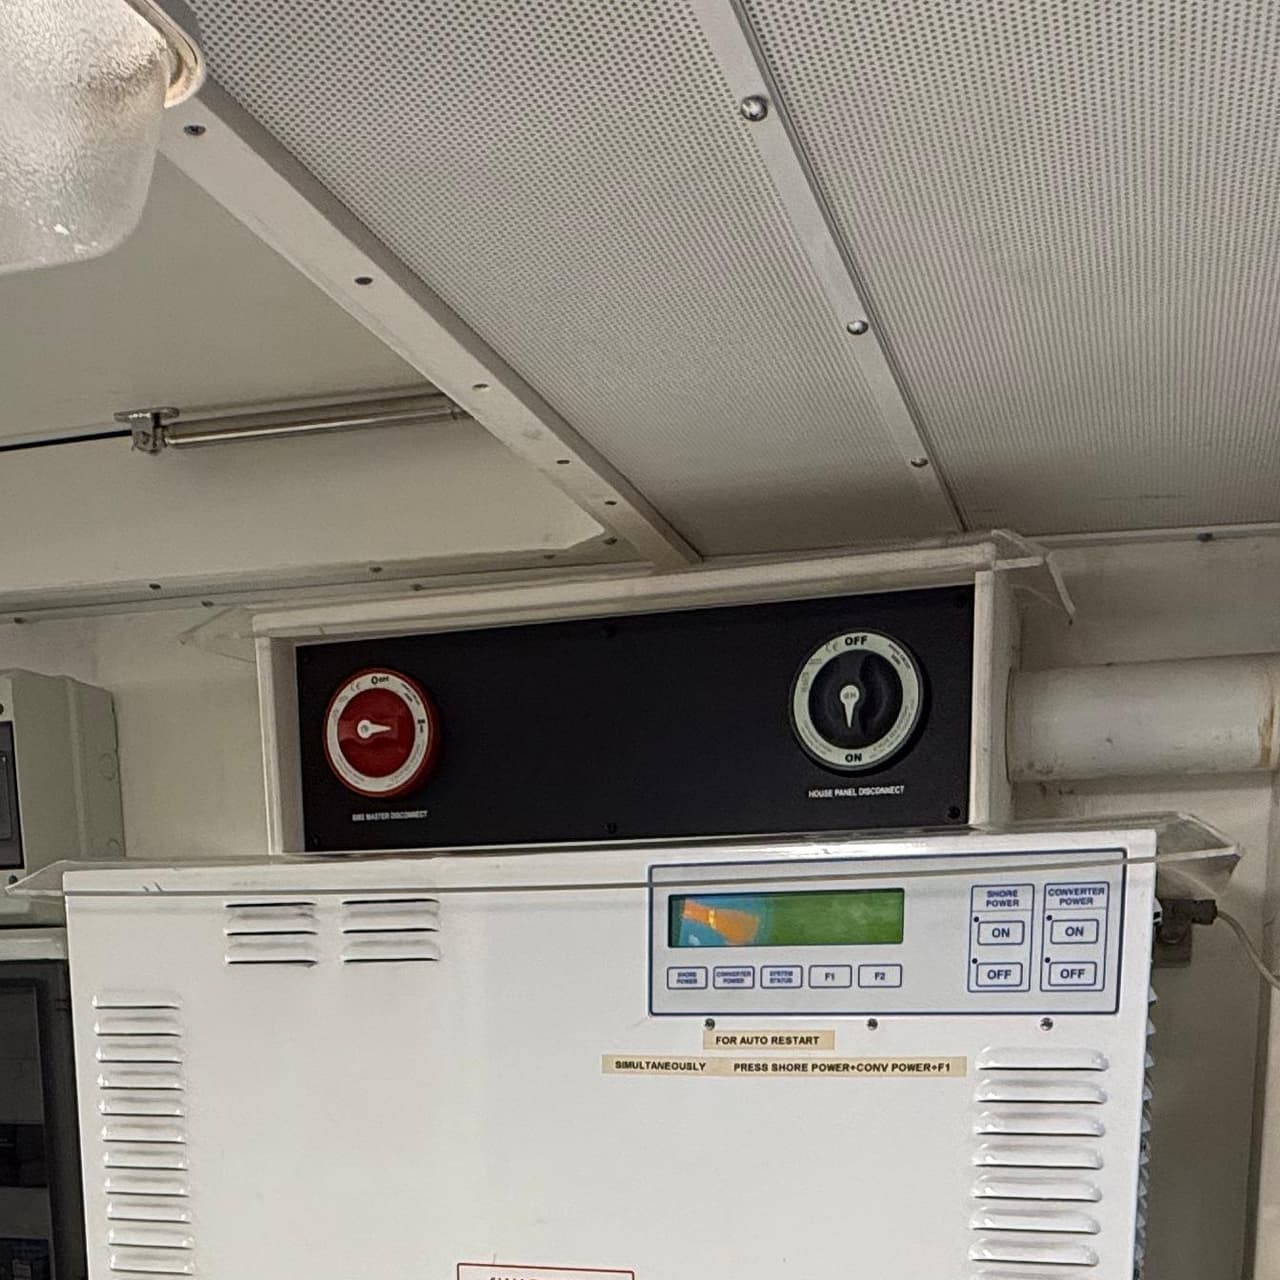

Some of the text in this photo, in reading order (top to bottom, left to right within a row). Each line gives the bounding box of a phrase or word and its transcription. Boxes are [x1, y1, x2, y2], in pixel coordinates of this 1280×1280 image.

[845, 635, 868, 646] OFF
[845, 753, 862, 763] ON
[808, 785, 905, 799] HOUSE PANEL DISCONNECT
[987, 889, 1018, 898] SHORE
[1048, 887, 1105, 897] CONVERTER
[986, 899, 1019, 908] POWER
[1059, 897, 1093, 906] POWER
[992, 927, 1010, 938] ON
[1065, 926, 1084, 937] ON
[716, 970, 751, 978] CONVERTER
[825, 973, 835, 981] F1
[874, 972, 885, 981] F2
[987, 969, 1012, 980] OFF
[1060, 968, 1085, 979] OFF
[716, 1035, 819, 1046] FOR AUTO RESTART
[615, 1060, 951, 1073] SIMULTANEOUSLY PRESS SHORE POWER+CONV POWER+F1
